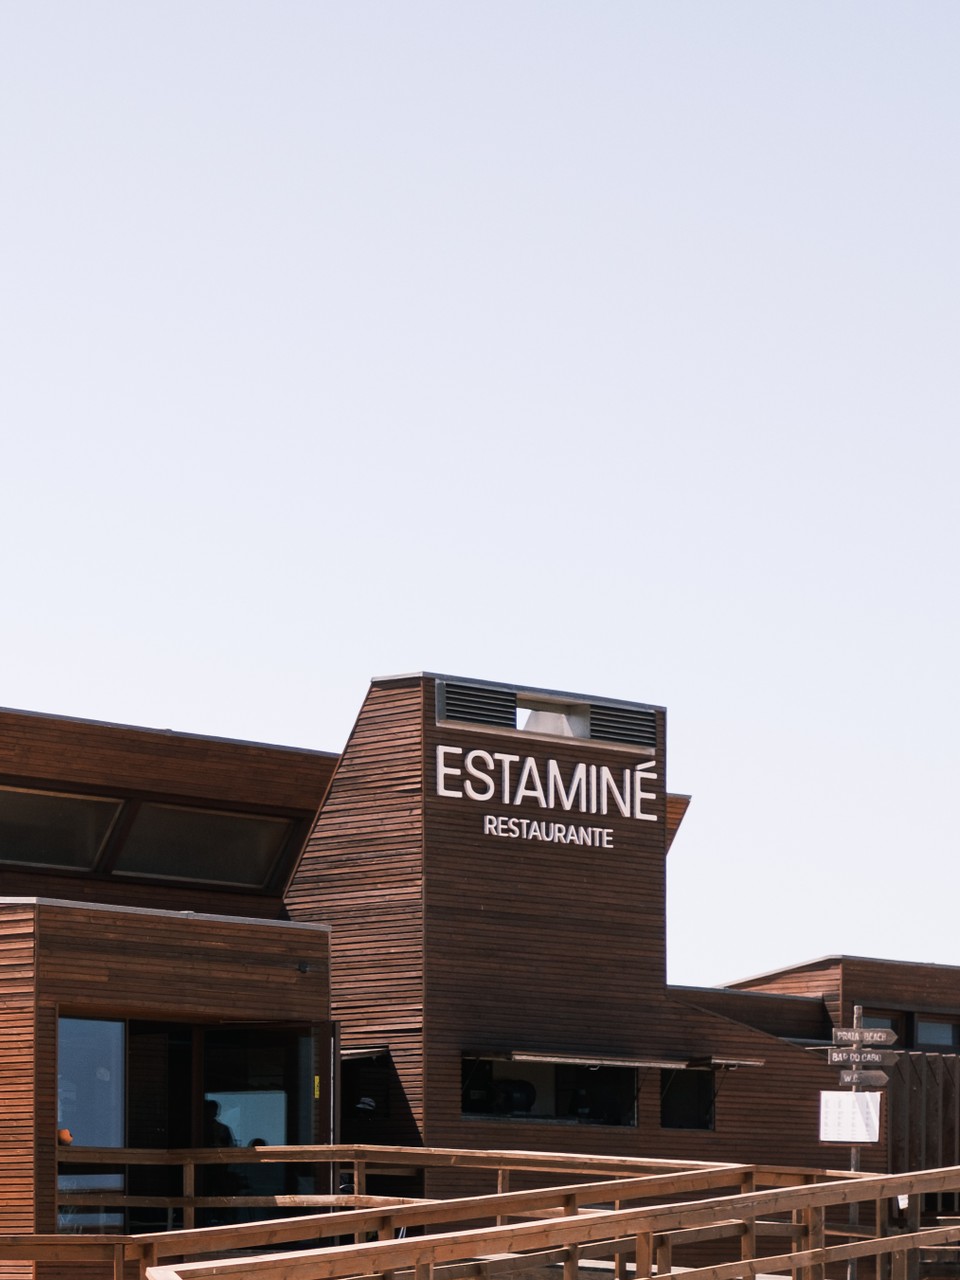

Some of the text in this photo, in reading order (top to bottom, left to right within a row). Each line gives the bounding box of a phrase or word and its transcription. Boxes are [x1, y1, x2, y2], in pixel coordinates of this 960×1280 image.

[436, 745, 658, 821] ESTAMINÉ
[484, 815, 614, 848] RESTAURANTE
[837, 1031, 887, 1042] PRAIA BEACH
[849, 1053, 861, 1062] DO
